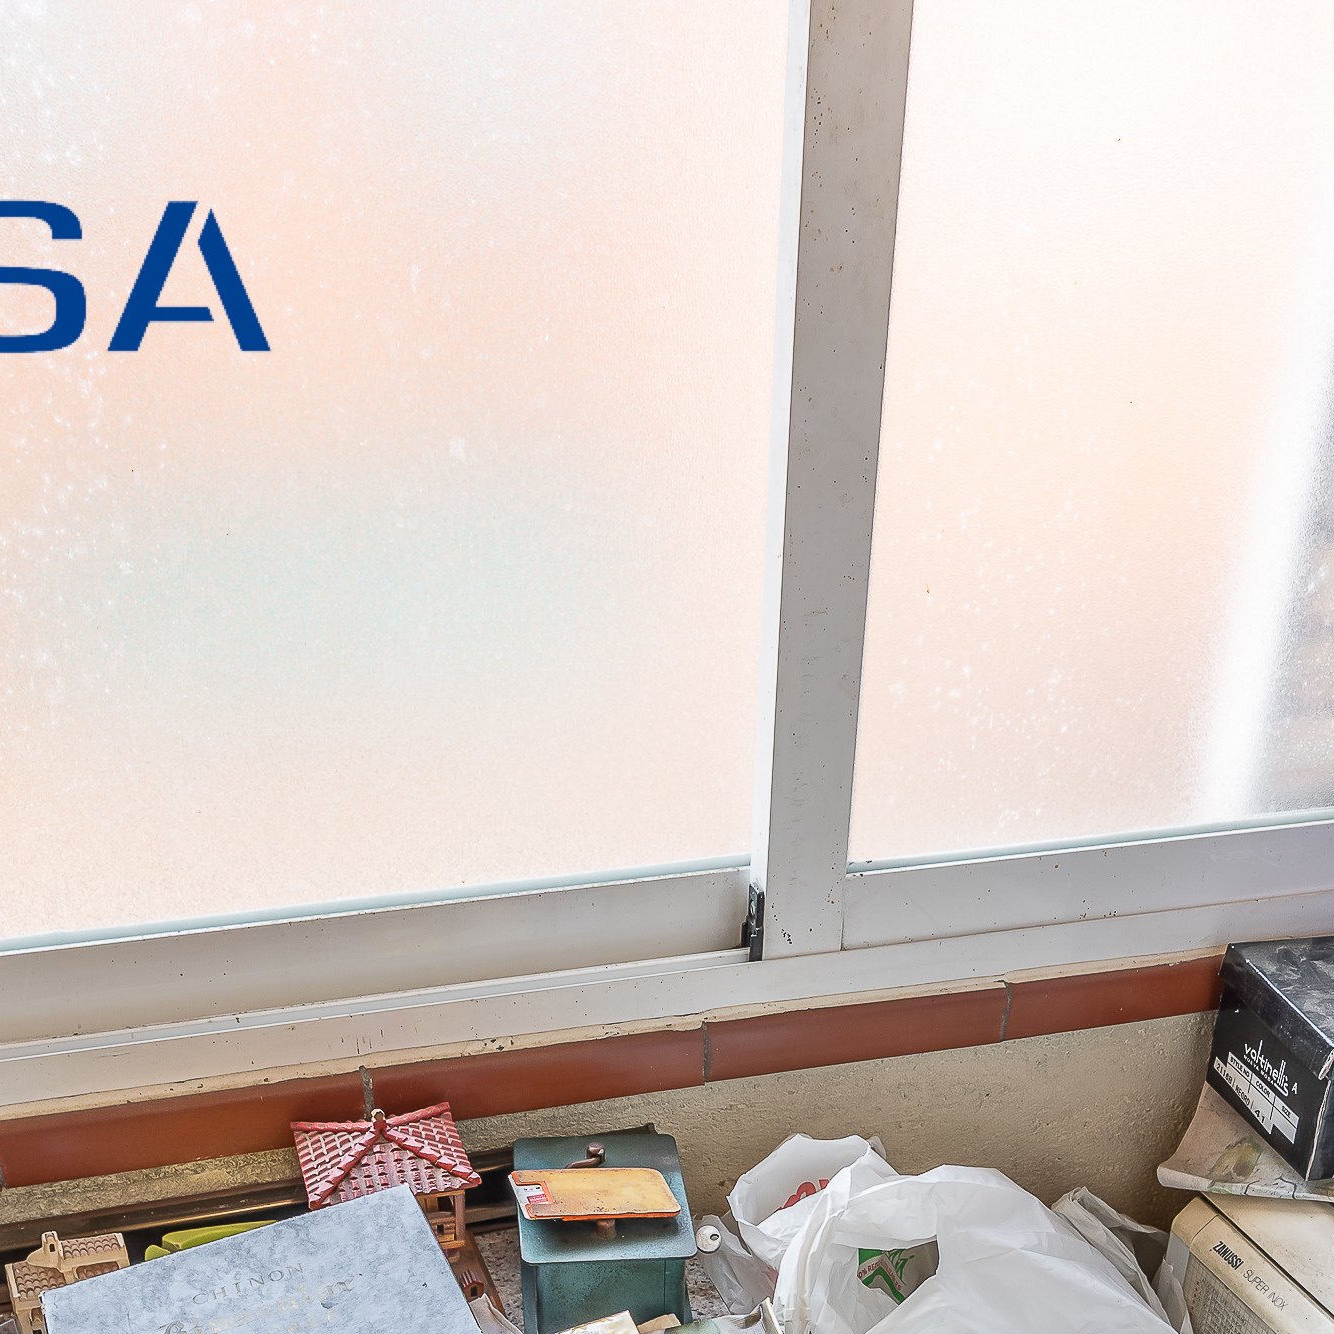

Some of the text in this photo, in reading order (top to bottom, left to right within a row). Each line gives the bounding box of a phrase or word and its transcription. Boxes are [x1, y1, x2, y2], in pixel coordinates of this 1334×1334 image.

[1255, 1079, 1270, 1097] COLOR
[190, 1262, 306, 1307] CHINON
[1212, 1240, 1289, 1312] ZANUSSI SUPER INOX
